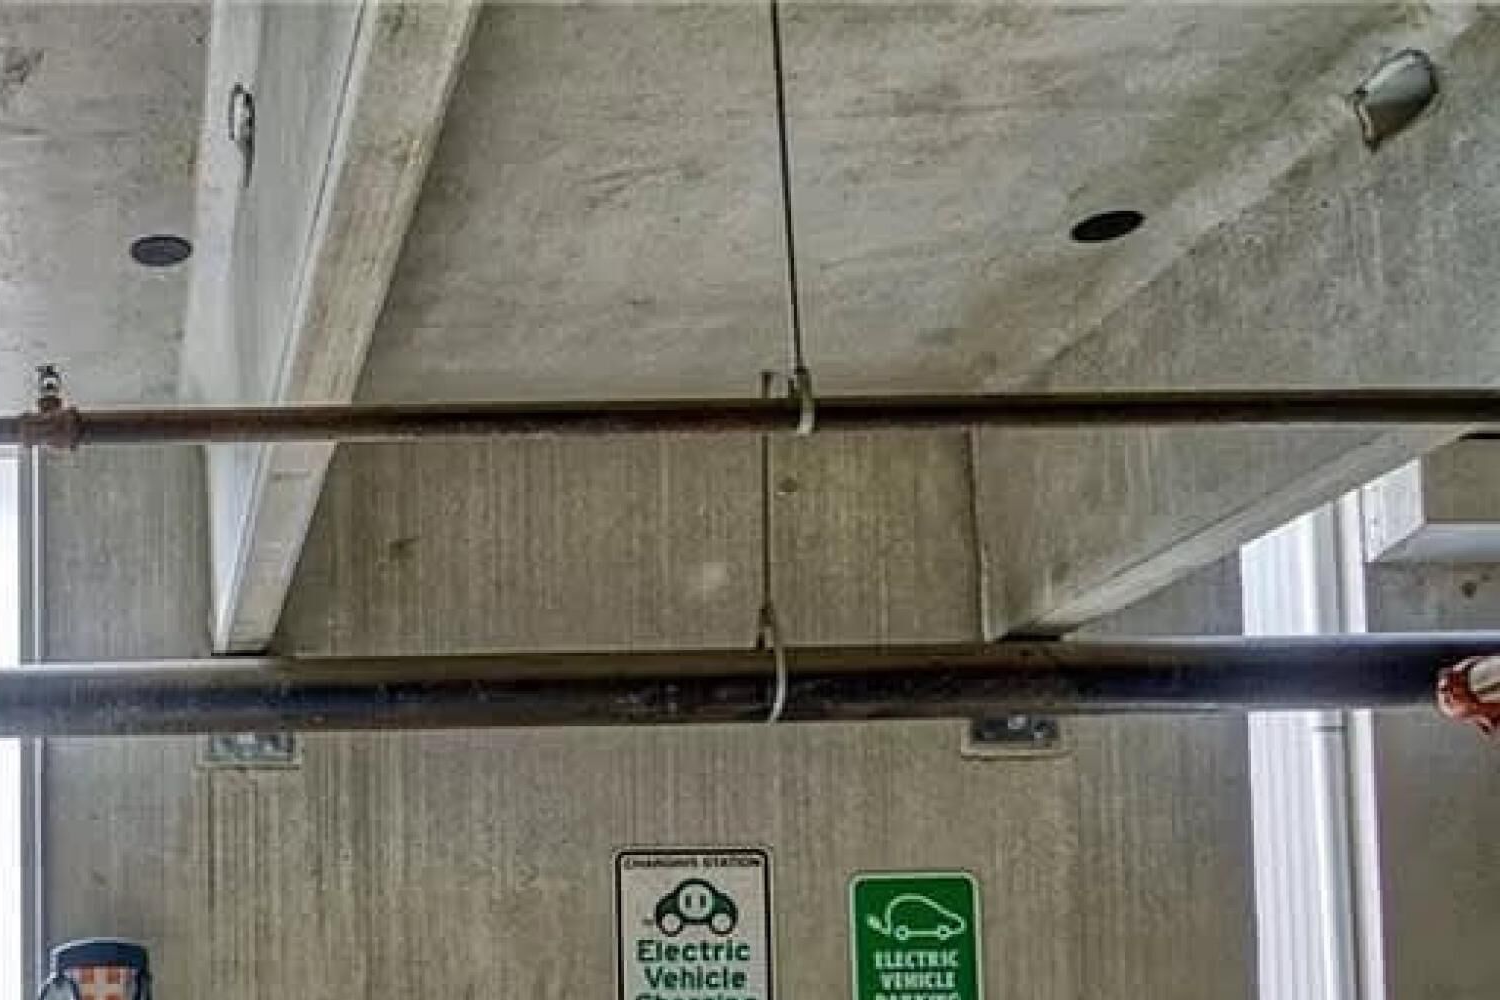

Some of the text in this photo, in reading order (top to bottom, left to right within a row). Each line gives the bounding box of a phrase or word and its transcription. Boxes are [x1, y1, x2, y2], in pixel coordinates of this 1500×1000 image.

[637, 939, 750, 961] Electric
[875, 950, 959, 968] ELECTRIC
[644, 966, 747, 989] Vehicle
[880, 972, 956, 989] VEHICLE
